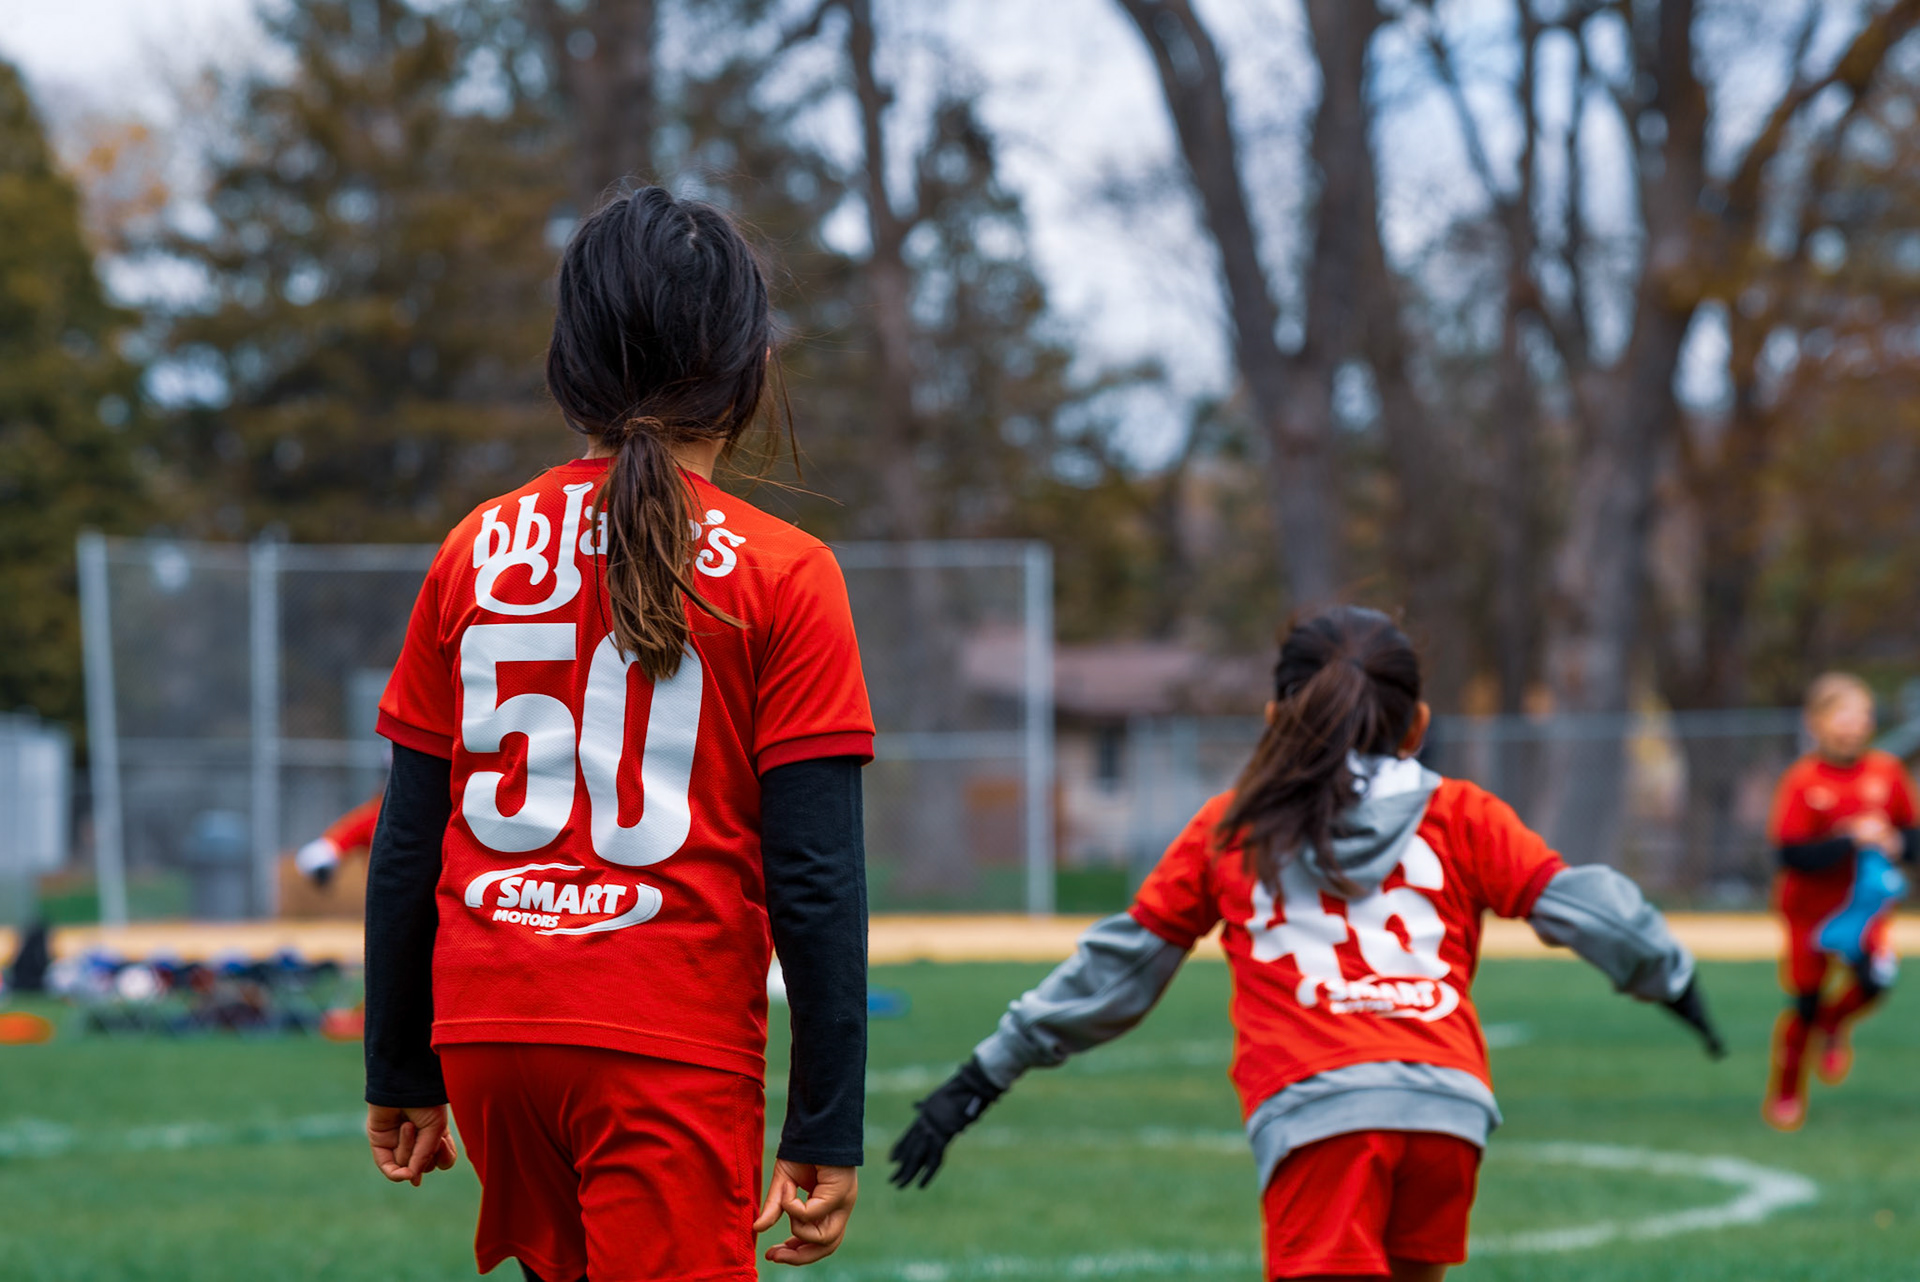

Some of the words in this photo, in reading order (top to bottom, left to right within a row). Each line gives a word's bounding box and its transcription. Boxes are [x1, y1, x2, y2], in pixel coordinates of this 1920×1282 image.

[472, 481, 747, 616] bbJa's
[460, 622, 703, 867] 50
[492, 909, 561, 928] MOTORS
[496, 876, 628, 915] SMART
[1244, 833, 1452, 981] 46
